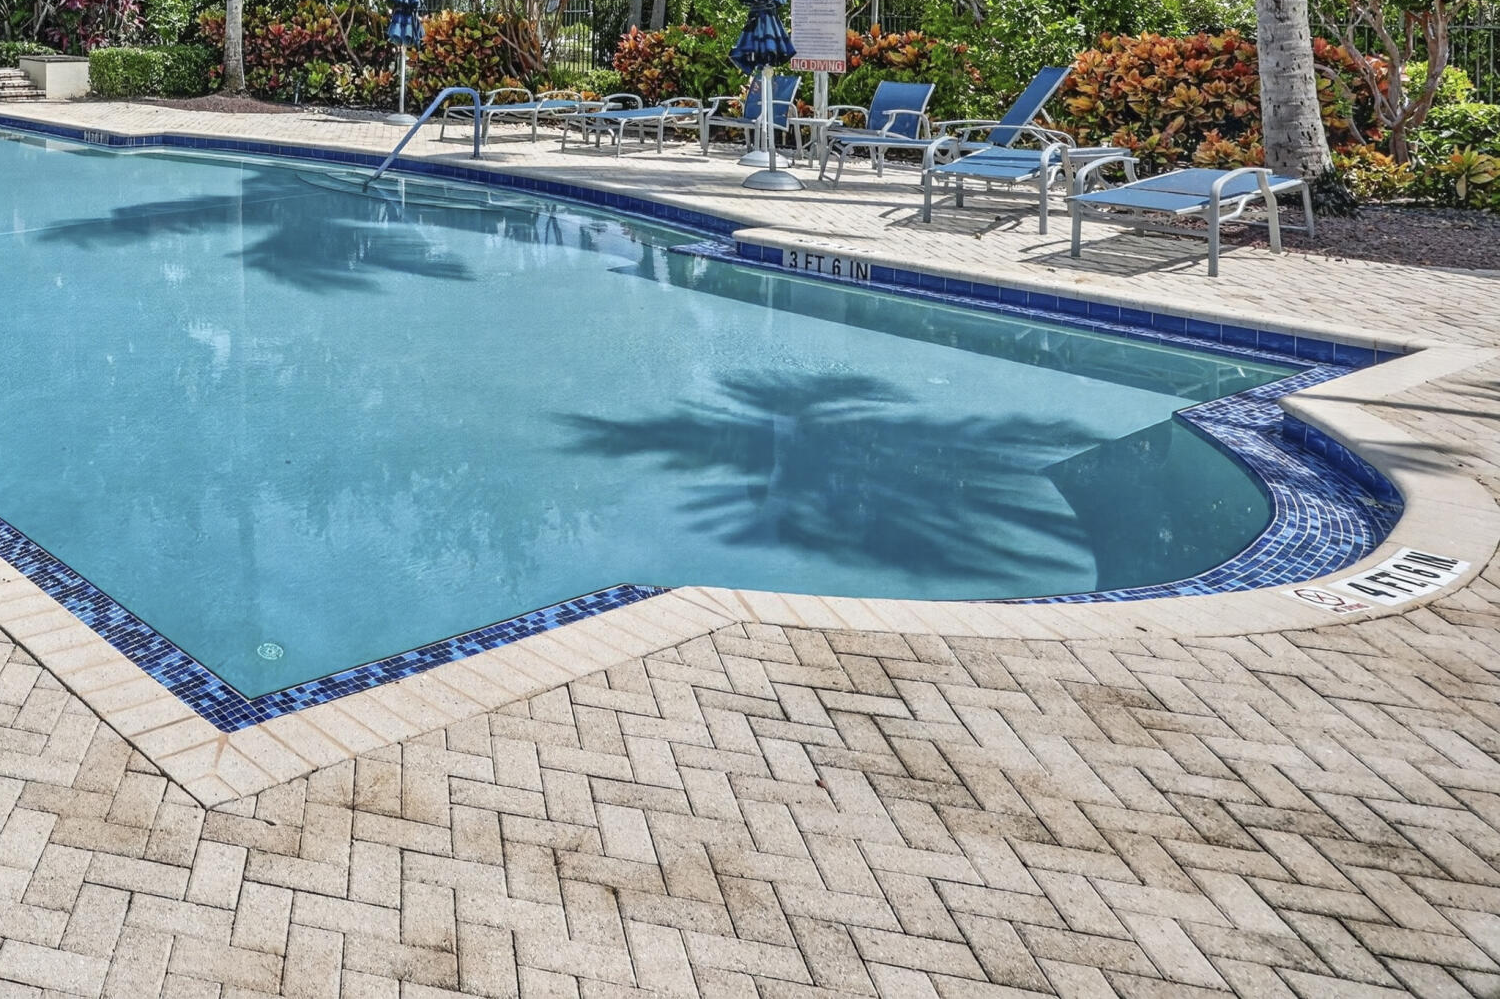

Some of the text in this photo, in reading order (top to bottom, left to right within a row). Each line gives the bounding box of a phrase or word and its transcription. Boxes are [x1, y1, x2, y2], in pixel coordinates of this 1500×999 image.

[810, 61, 842, 72] DIVING
[789, 251, 868, 280] 3 FT 6 IN
[1347, 582, 1397, 598] 4
[1392, 564, 1441, 579] 6
